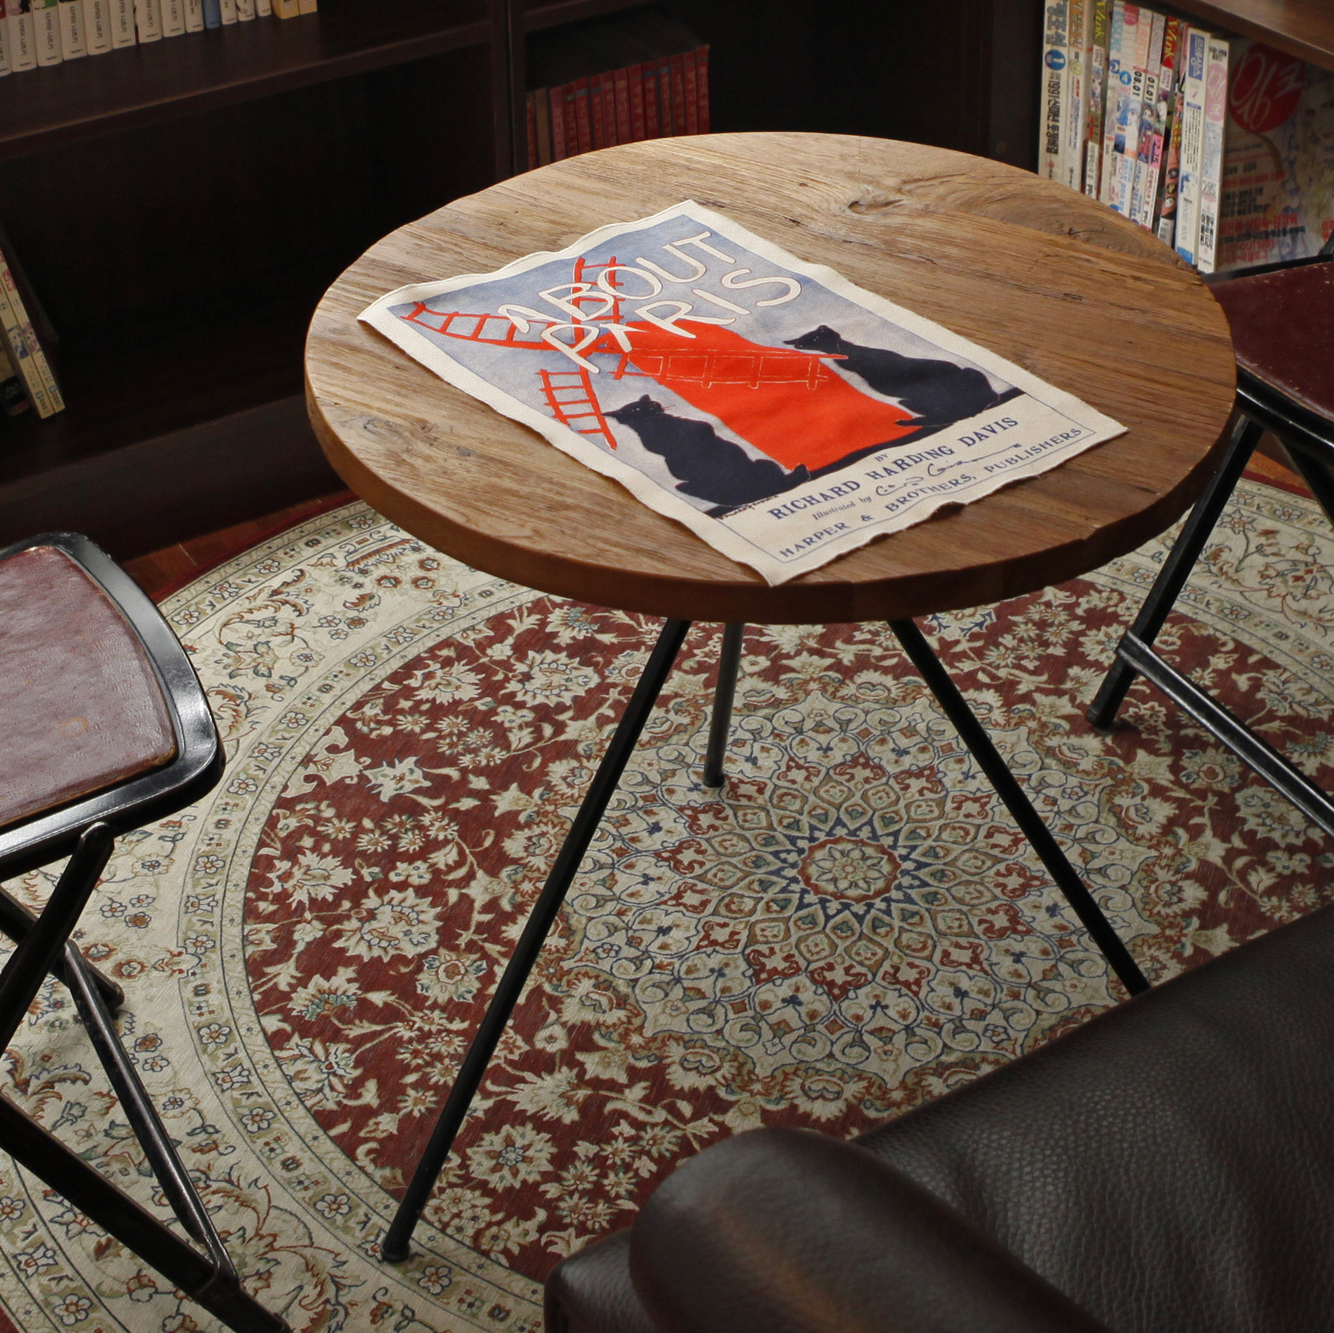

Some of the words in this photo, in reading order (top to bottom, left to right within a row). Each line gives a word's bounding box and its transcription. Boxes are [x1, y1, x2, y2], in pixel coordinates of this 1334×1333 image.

[1164, 17, 1179, 64] Wink
[497, 230, 737, 334] ABOUT
[540, 268, 802, 375] PARIS
[767, 479, 861, 521] RICHARD
[864, 445, 955, 481] HARDING
[957, 416, 1019, 448] DAVIS
[779, 521, 851, 558] HARPER
[860, 513, 874, 524] &
[885, 471, 978, 513] BROTHERS,
[984, 427, 1083, 474] PUBLISHERS
[812, 501, 857, 520] Illustrated
[859, 495, 872, 507] by
[874, 452, 889, 463] BY
